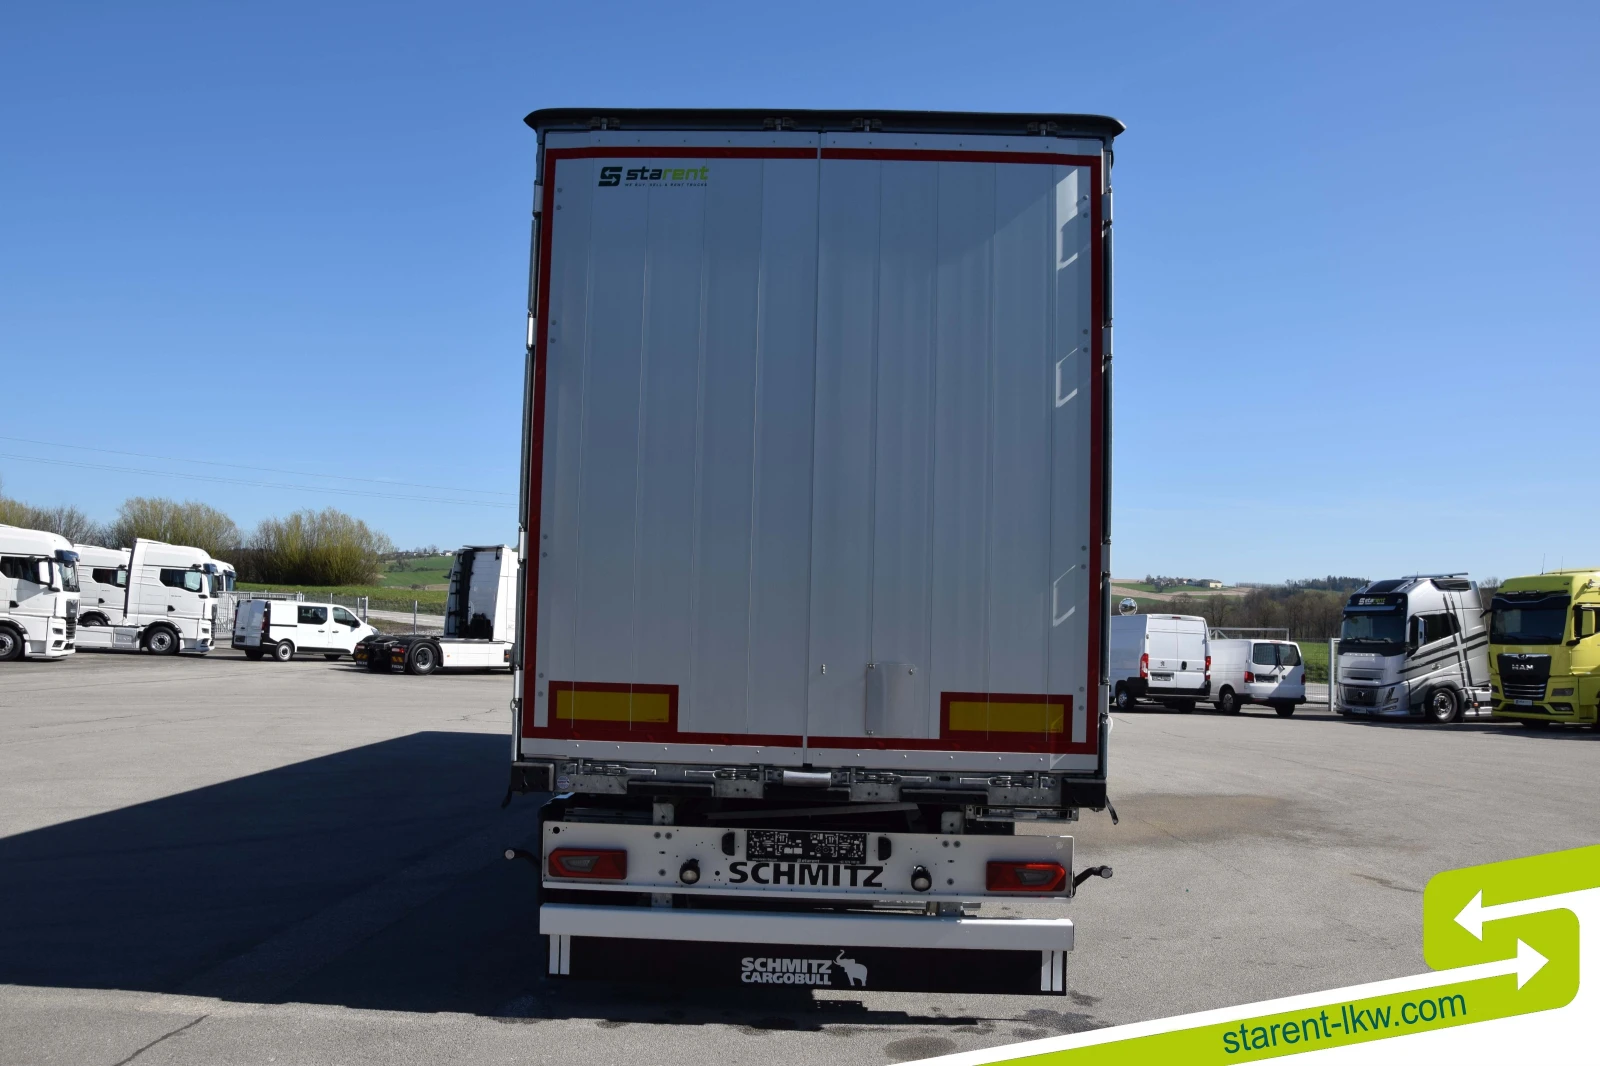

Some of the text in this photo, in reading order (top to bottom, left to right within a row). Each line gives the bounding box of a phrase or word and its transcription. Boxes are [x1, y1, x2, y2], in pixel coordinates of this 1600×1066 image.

[626, 166, 709, 180] starent
[729, 861, 884, 887] SCHMITZ
[741, 957, 832, 973] SCHMITZ
[741, 972, 832, 985] CARGOBULL
